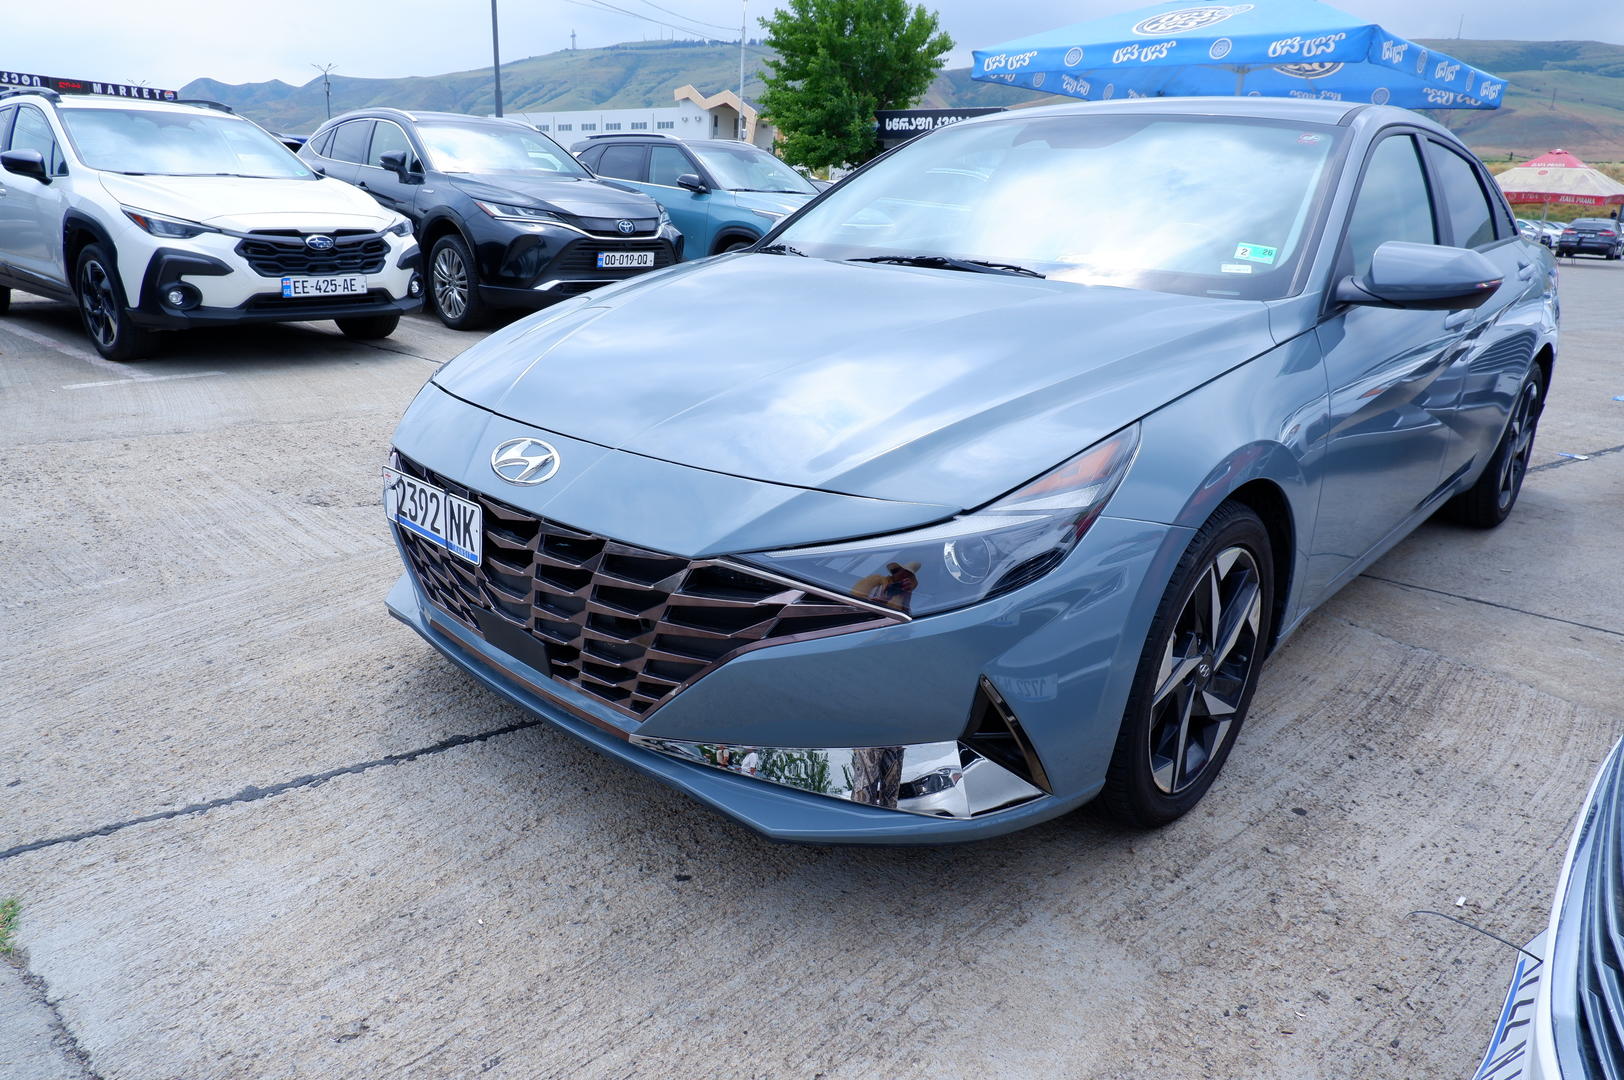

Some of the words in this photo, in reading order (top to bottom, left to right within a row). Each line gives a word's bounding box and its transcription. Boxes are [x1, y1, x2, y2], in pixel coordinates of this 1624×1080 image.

[93, 82, 161, 100] MARKET
[293, 278, 357, 294] EE-425-AE
[449, 500, 475, 552] NK
